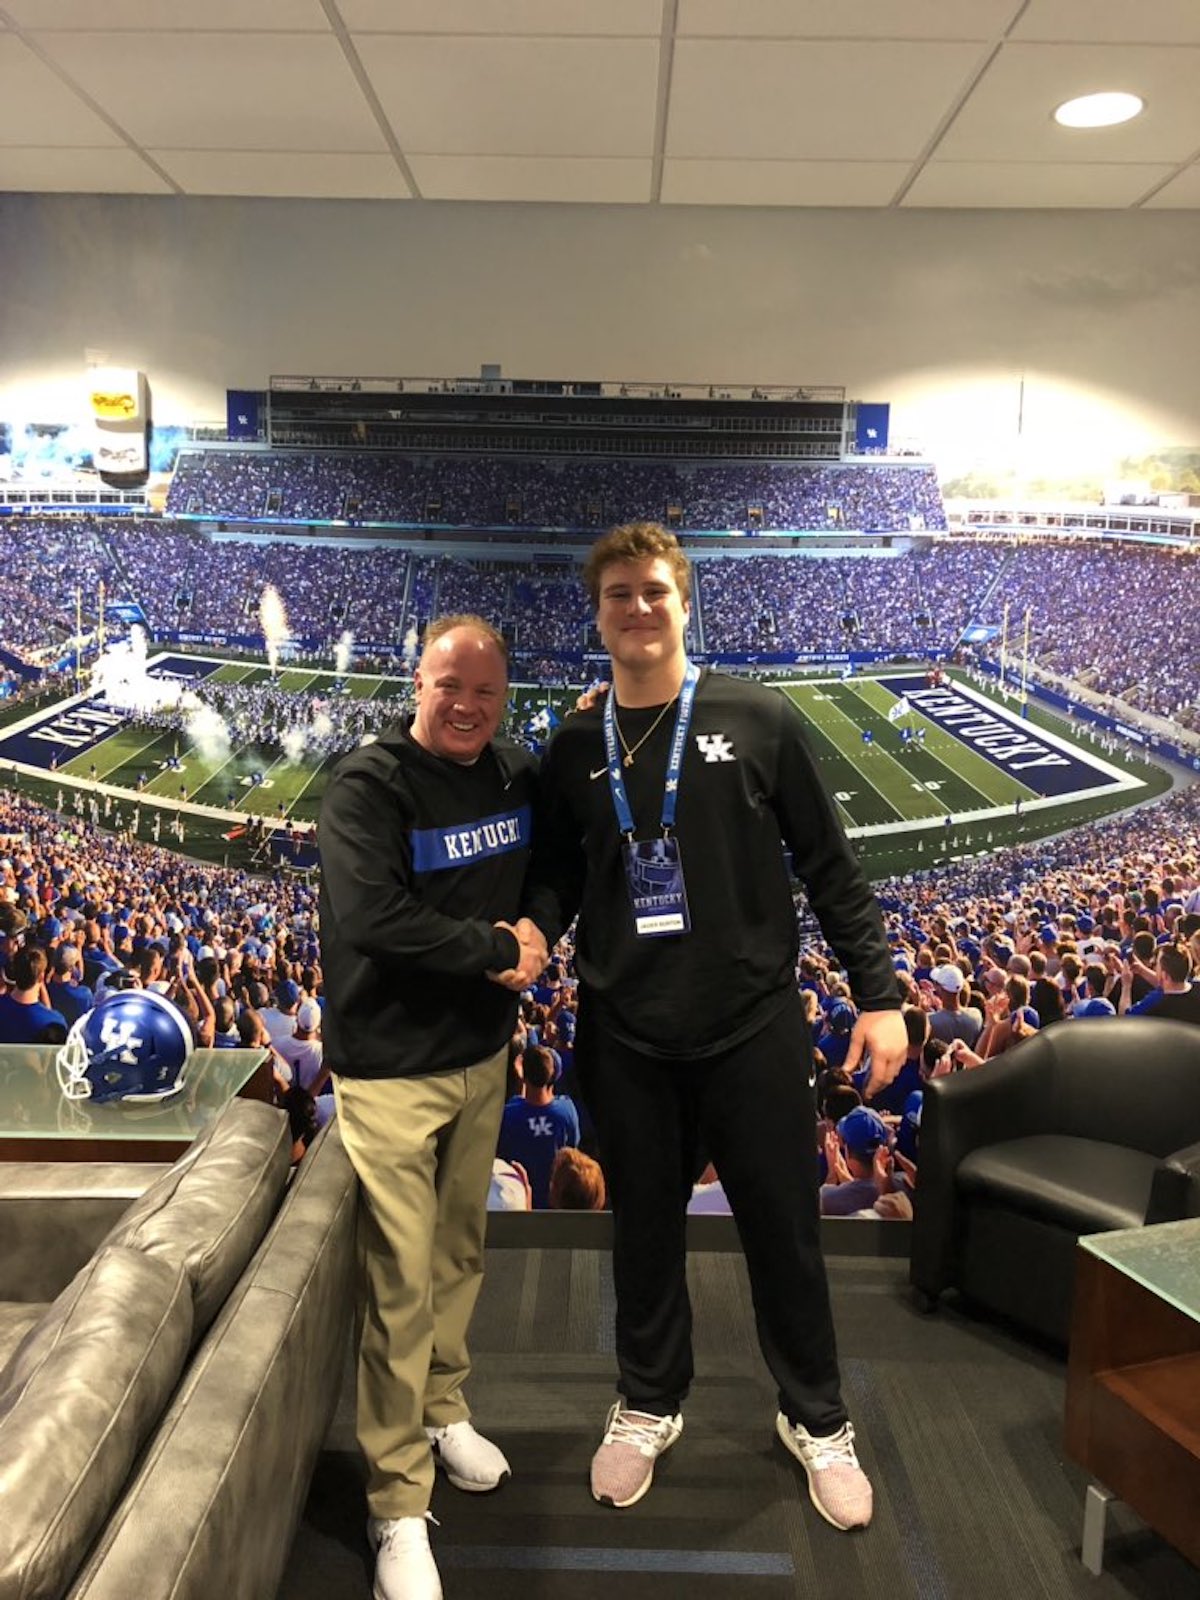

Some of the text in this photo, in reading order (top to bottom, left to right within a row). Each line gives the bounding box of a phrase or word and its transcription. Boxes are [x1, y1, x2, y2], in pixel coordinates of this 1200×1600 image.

[901, 687, 1072, 770] KENTUCKY
[696, 734, 737, 762] UK
[443, 817, 520, 860] KENUCK
[633, 892, 682, 909] KENTUCKY
[101, 1016, 143, 1065] UK
[528, 1116, 553, 1137] UK
